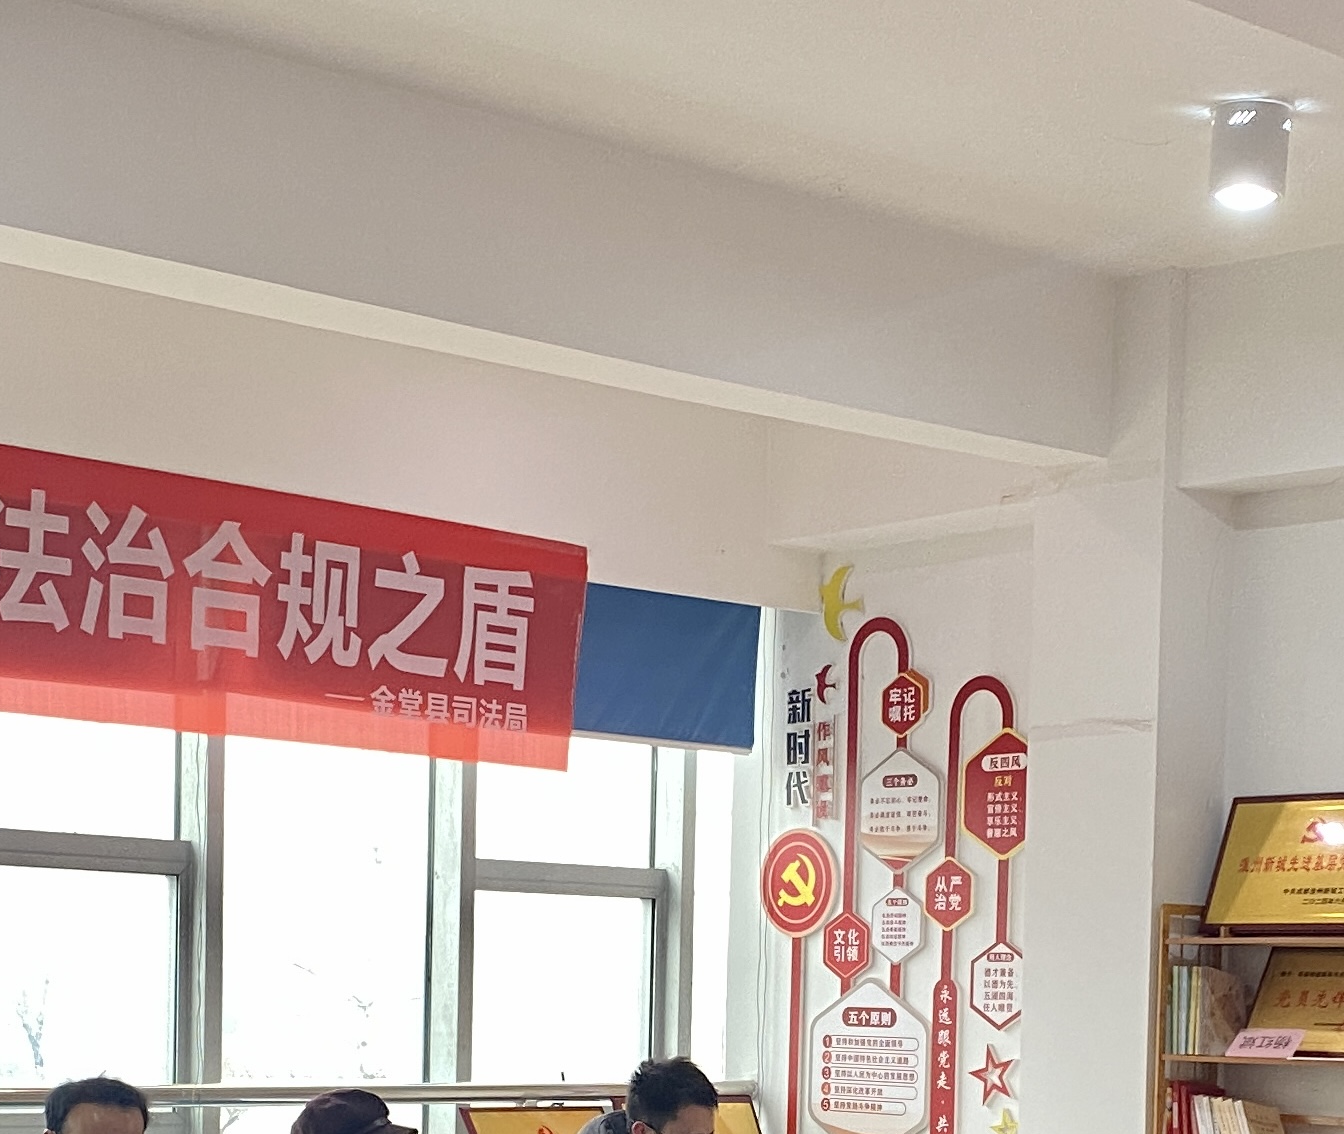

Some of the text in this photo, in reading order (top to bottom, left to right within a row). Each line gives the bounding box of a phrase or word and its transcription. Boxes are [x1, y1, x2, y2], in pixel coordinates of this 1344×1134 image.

[889, 688, 915, 704] 牢记
[889, 705, 915, 722] 嘱托
[786, 688, 811, 806] 新时代
[994, 775, 1013, 787] 反对
[935, 876, 963, 893] 从严
[934, 894, 963, 911] 治党
[833, 928, 860, 946] 文化
[833, 946, 860, 963] 引领
[848, 1011, 892, 1026] 五个原则
